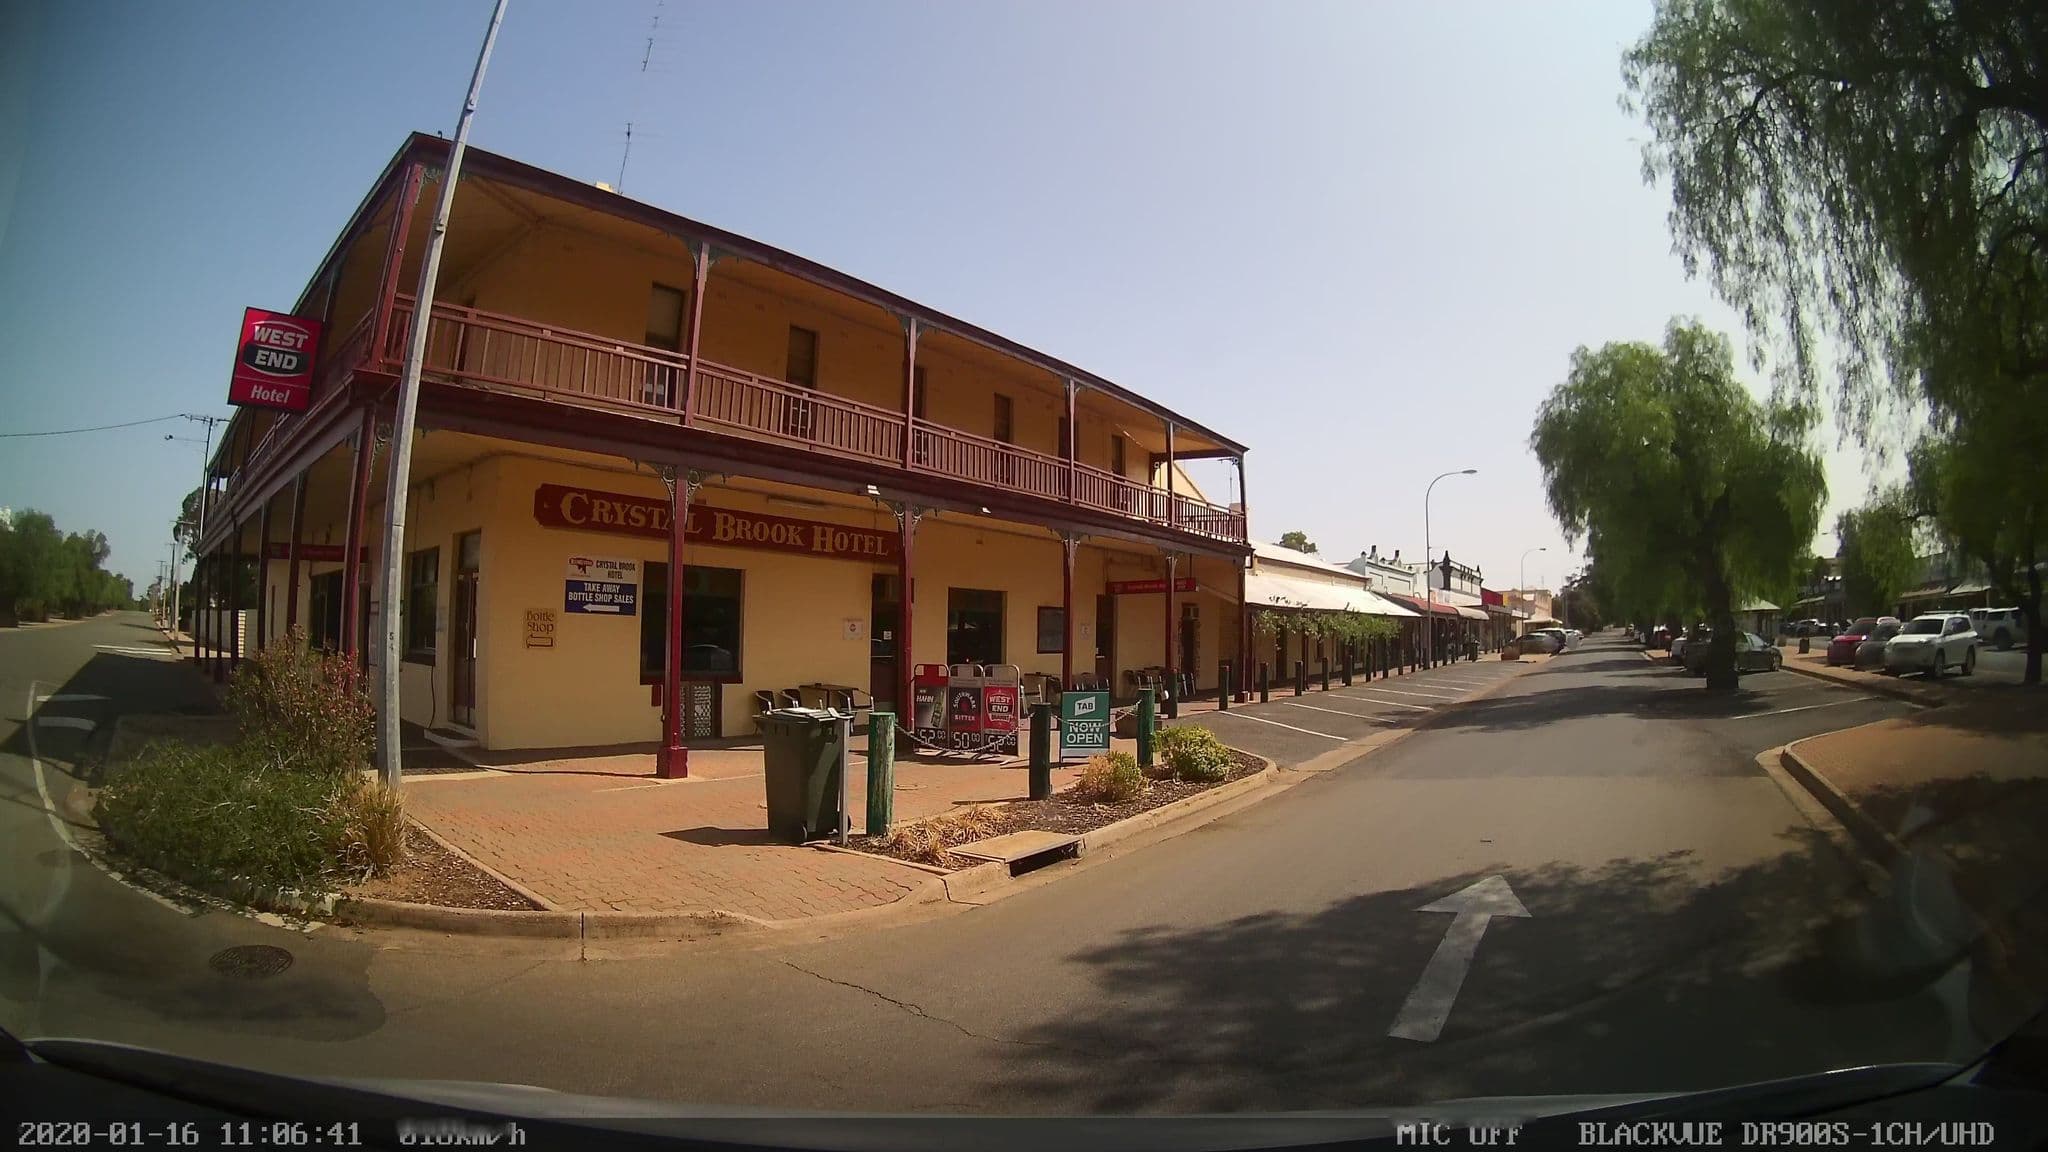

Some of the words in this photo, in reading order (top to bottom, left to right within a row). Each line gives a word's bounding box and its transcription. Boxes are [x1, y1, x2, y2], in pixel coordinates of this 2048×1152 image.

[254, 325, 309, 348] WEST
[254, 350, 298, 370] END
[250, 384, 290, 404] Hotel
[712, 511, 805, 547] BROOK
[811, 525, 888, 556] HOTEL
[595, 559, 617, 570] CRYSTAL
[584, 582, 600, 592] TAKE
[602, 583, 620, 593] AWAY
[568, 591, 593, 602] BOTTLE
[594, 593, 613, 603] SHOP
[614, 594, 634, 604] SALES
[526, 610, 555, 622] Bottle
[527, 621, 554, 635] Shop
[916, 695, 935, 703] HAHN
[989, 695, 1011, 703] WEST
[991, 704, 1009, 712] END
[1077, 702, 1094, 710] TAB
[1069, 722, 1102, 733] NOW
[1066, 733, 1103, 744] OPEN
